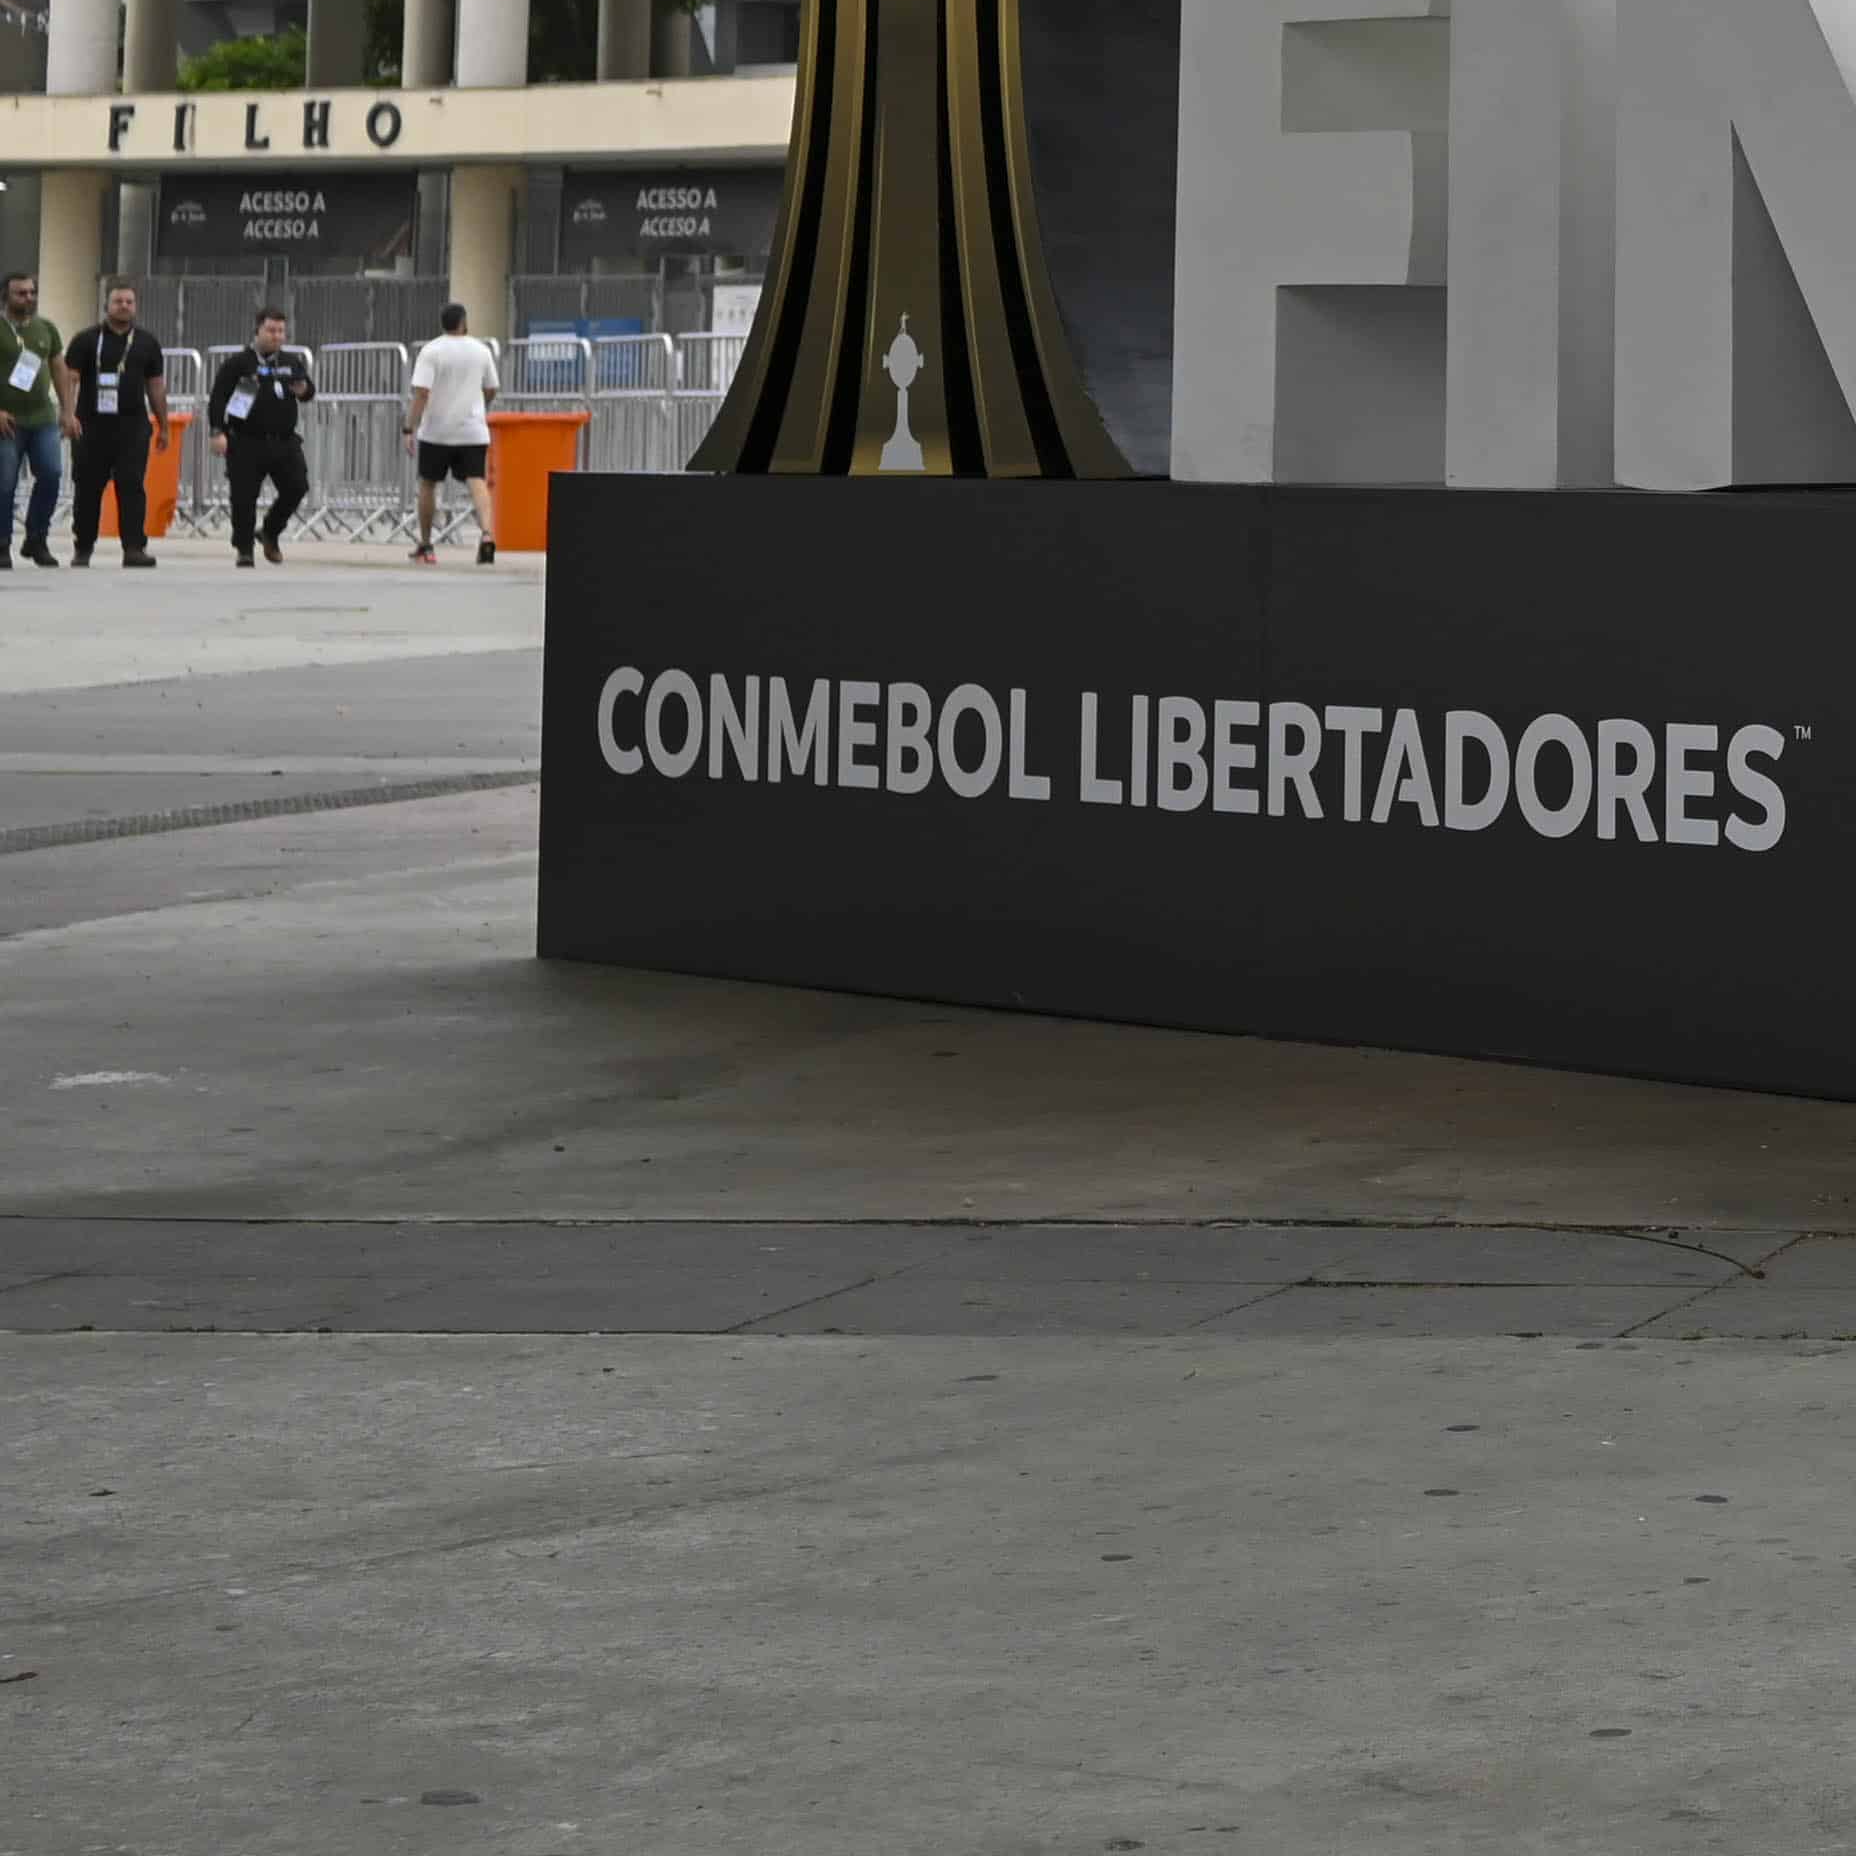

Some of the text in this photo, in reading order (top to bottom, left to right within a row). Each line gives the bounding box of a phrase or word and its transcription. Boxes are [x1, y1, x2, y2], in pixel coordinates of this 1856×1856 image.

[107, 100, 402, 152] FILHO
[239, 191, 327, 214] ACESSO A
[636, 188, 718, 211] ACESSO A
[243, 219, 320, 240] ACCESO A
[639, 216, 711, 238] ACCESO A
[598, 666, 1051, 801] CONMEBOL
[1079, 691, 1786, 852] LIBERTADORES
